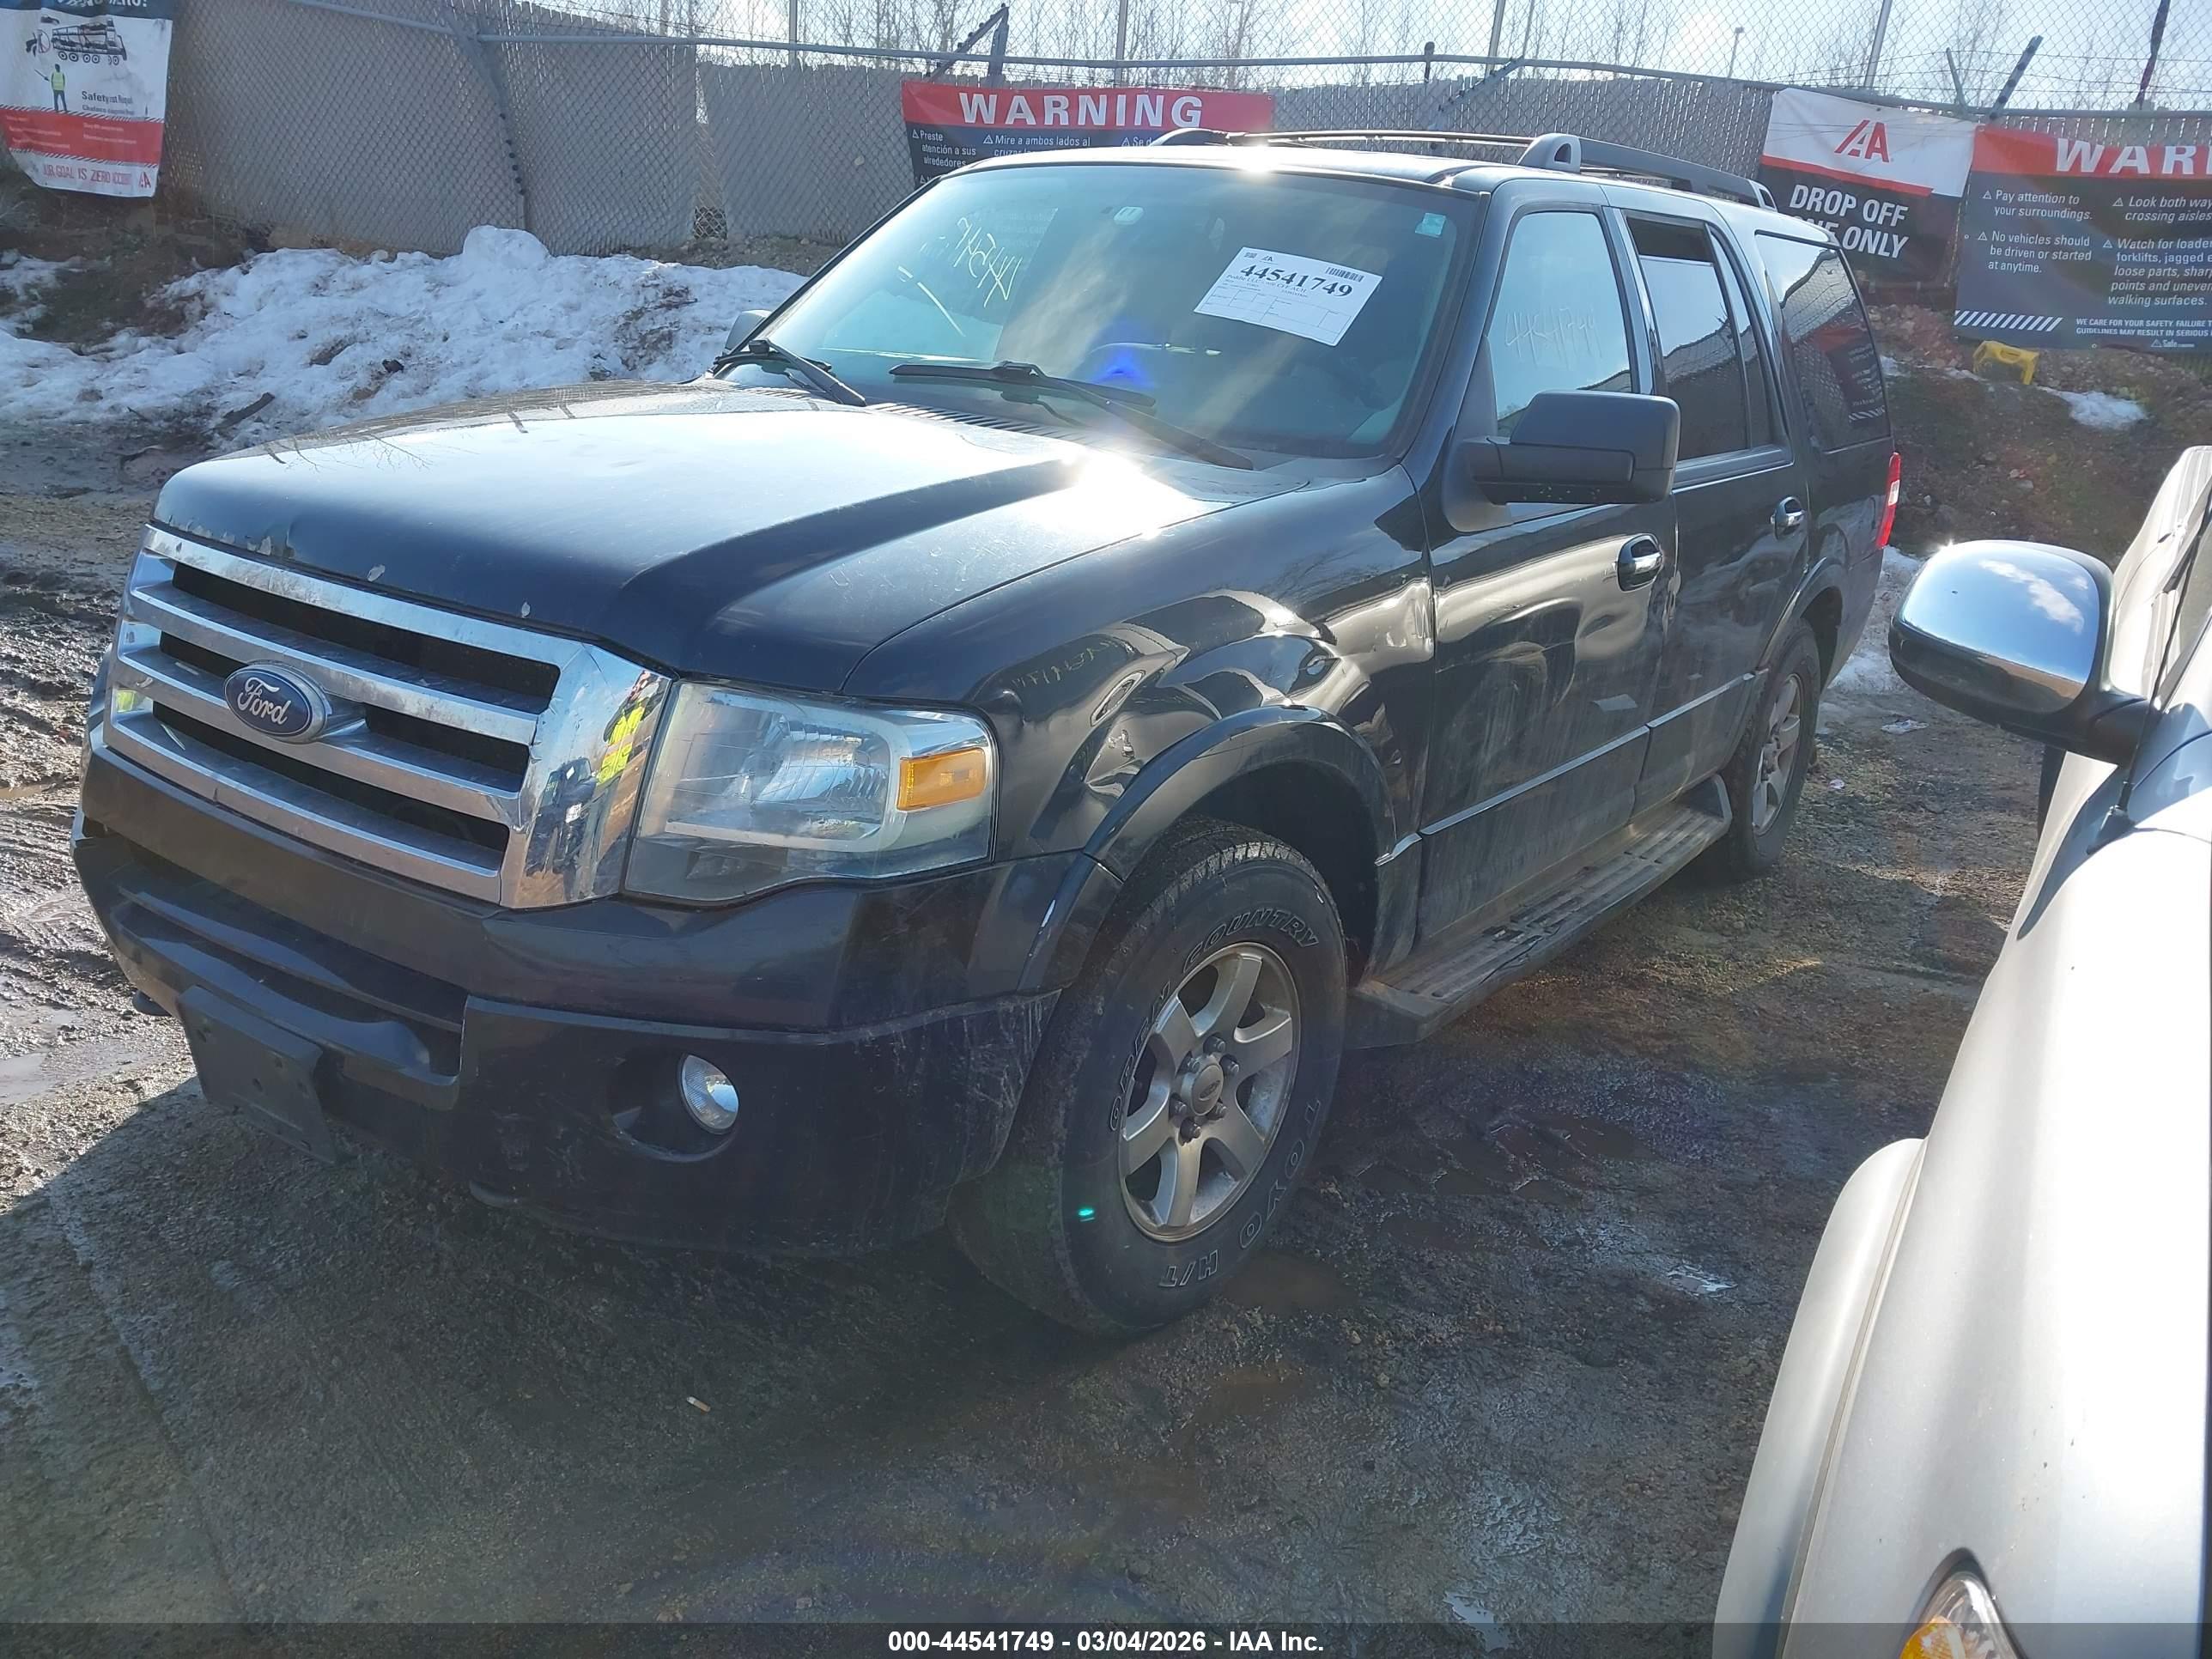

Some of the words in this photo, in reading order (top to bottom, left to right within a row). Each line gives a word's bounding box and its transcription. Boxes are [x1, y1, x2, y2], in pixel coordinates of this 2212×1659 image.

[82, 91, 109, 104] Safety
[959, 92, 1202, 128] WARNING
[920, 131, 943, 142] Preste
[995, 135, 1015, 145] Mire
[1025, 135, 1054, 146] ambos
[1056, 136, 1080, 147] lados
[1083, 137, 1091, 147] al
[922, 144, 952, 155] atención
[78, 167, 87, 180] IS
[1996, 190, 2015, 204] Pay
[2018, 192, 2065, 204] attention
[2069, 194, 2080, 204] to
[2129, 196, 2157, 207] Look
[2160, 197, 2186, 207] both
[1790, 185, 1856, 216] DROP
[1863, 199, 1909, 227] OFF
[1994, 206, 2016, 216] your
[2018, 208, 2093, 222] surroundings.
[2125, 210, 2175, 223] crossing
[2178, 210, 2212, 222] aisles
[1842, 226, 1910, 258] ONLY
[1992, 230, 2006, 242] No
[2008, 233, 2051, 246] vehicles
[2053, 234, 2090, 246] should
[2117, 238, 2154, 249] Watch
[2157, 239, 2173, 249] for
[1990, 244, 2002, 256] be
[2005, 246, 2035, 258] driven
[2038, 250, 2050, 259] or
[2051, 250, 2092, 261] started
[2117, 252, 2161, 264] forklifts,
[2164, 252, 2203, 264] jagged
[1989, 261, 1999, 270] at
[2001, 261, 2042, 273] anytime.
[2114, 264, 2145, 276] loose
[2148, 267, 2179, 279] parts,
[1241, 264, 1352, 298] 44541749
[2111, 281, 2146, 292] points
[2148, 281, 2171, 291] and
[2108, 294, 2151, 307] walking
[2154, 295, 2208, 306] surfaces.
[237, 677, 291, 725] Ford
[1183, 908, 1320, 974] COUNTRY
[1239, 1099, 1322, 1249] TOYO
